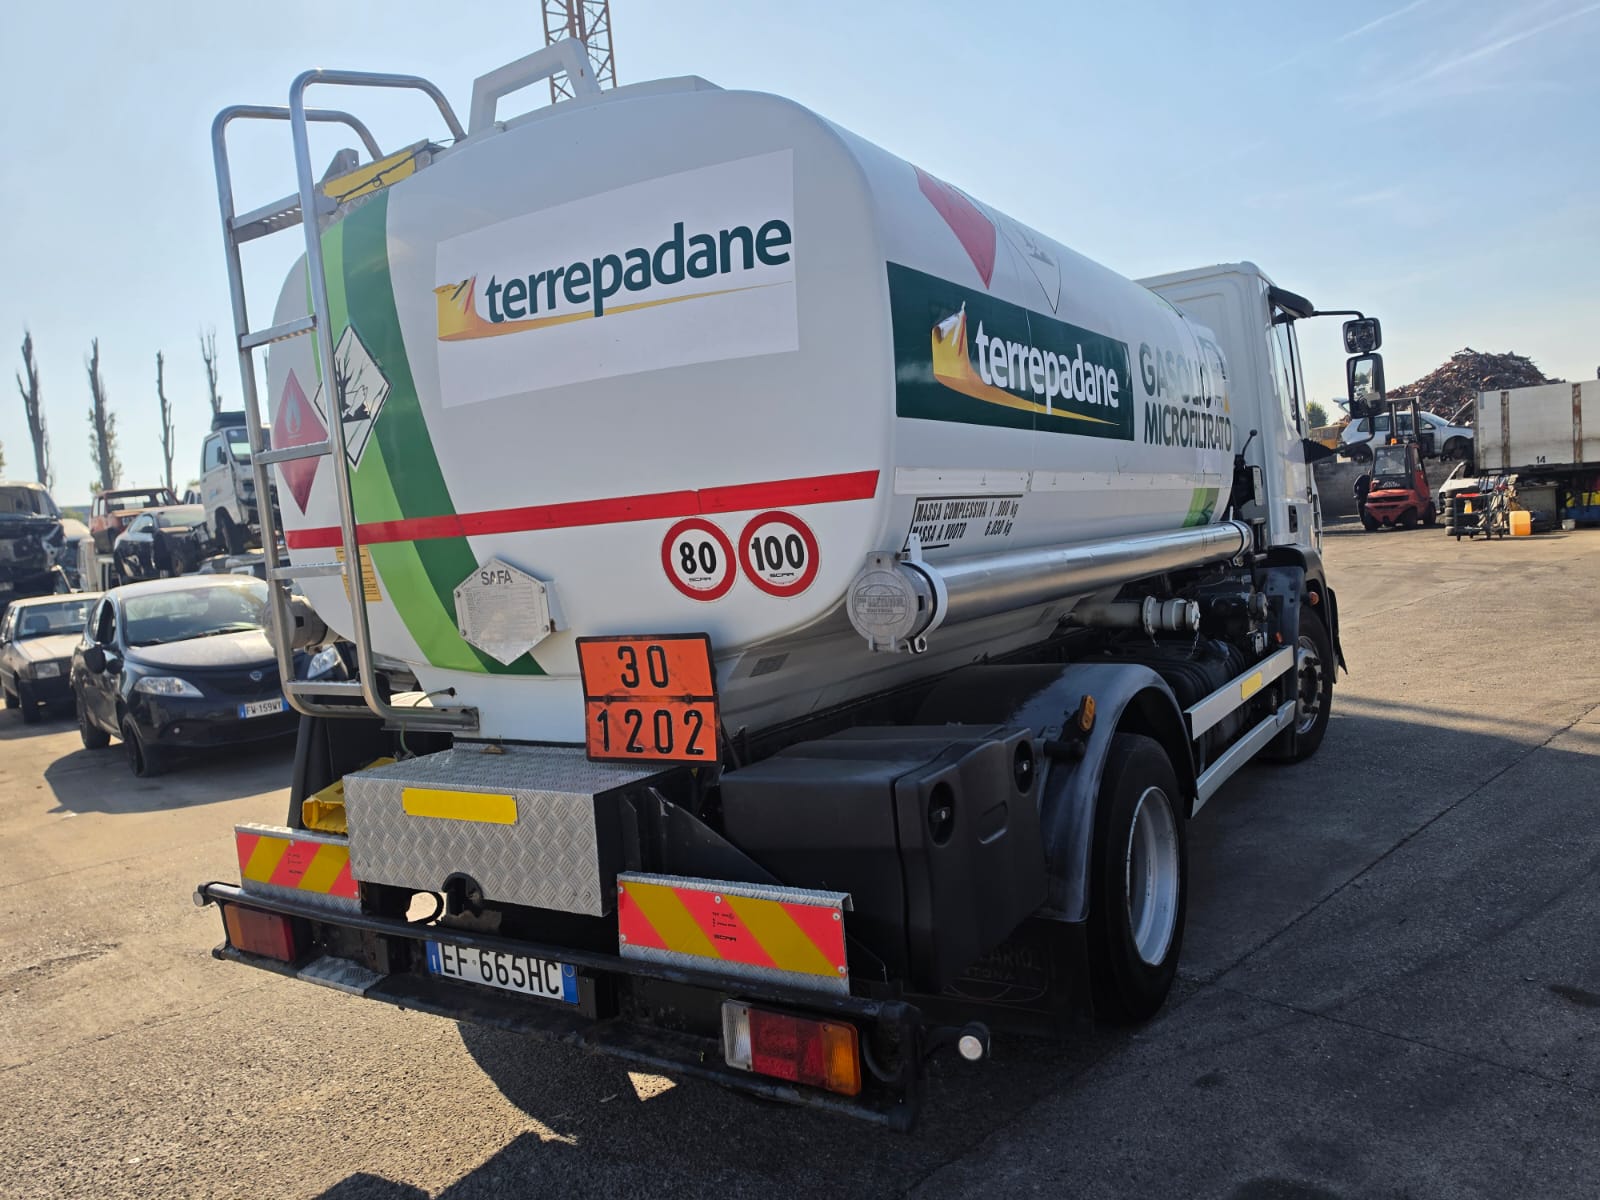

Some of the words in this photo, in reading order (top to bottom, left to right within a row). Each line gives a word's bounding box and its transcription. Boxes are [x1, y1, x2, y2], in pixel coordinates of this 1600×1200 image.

[485, 219, 792, 324] terrepadane
[975, 320, 1120, 415] terrepadane
[1144, 401, 1232, 452] MICROFILTRATO
[1536, 455, 1546, 464] 14
[916, 502, 943, 522] MASSA
[943, 501, 988, 520] COMPLESSIVA
[936, 524, 945, 541] A
[944, 522, 967, 541] VUOTO
[1002, 519, 1013, 537] kg
[679, 541, 717, 574] 80
[751, 533, 805, 571] 100
[481, 569, 513, 586] SAFA
[617, 645, 669, 689] 30
[596, 708, 705, 755] 1202
[442, 944, 468, 977] EF
[479, 950, 560, 995] 665HC
